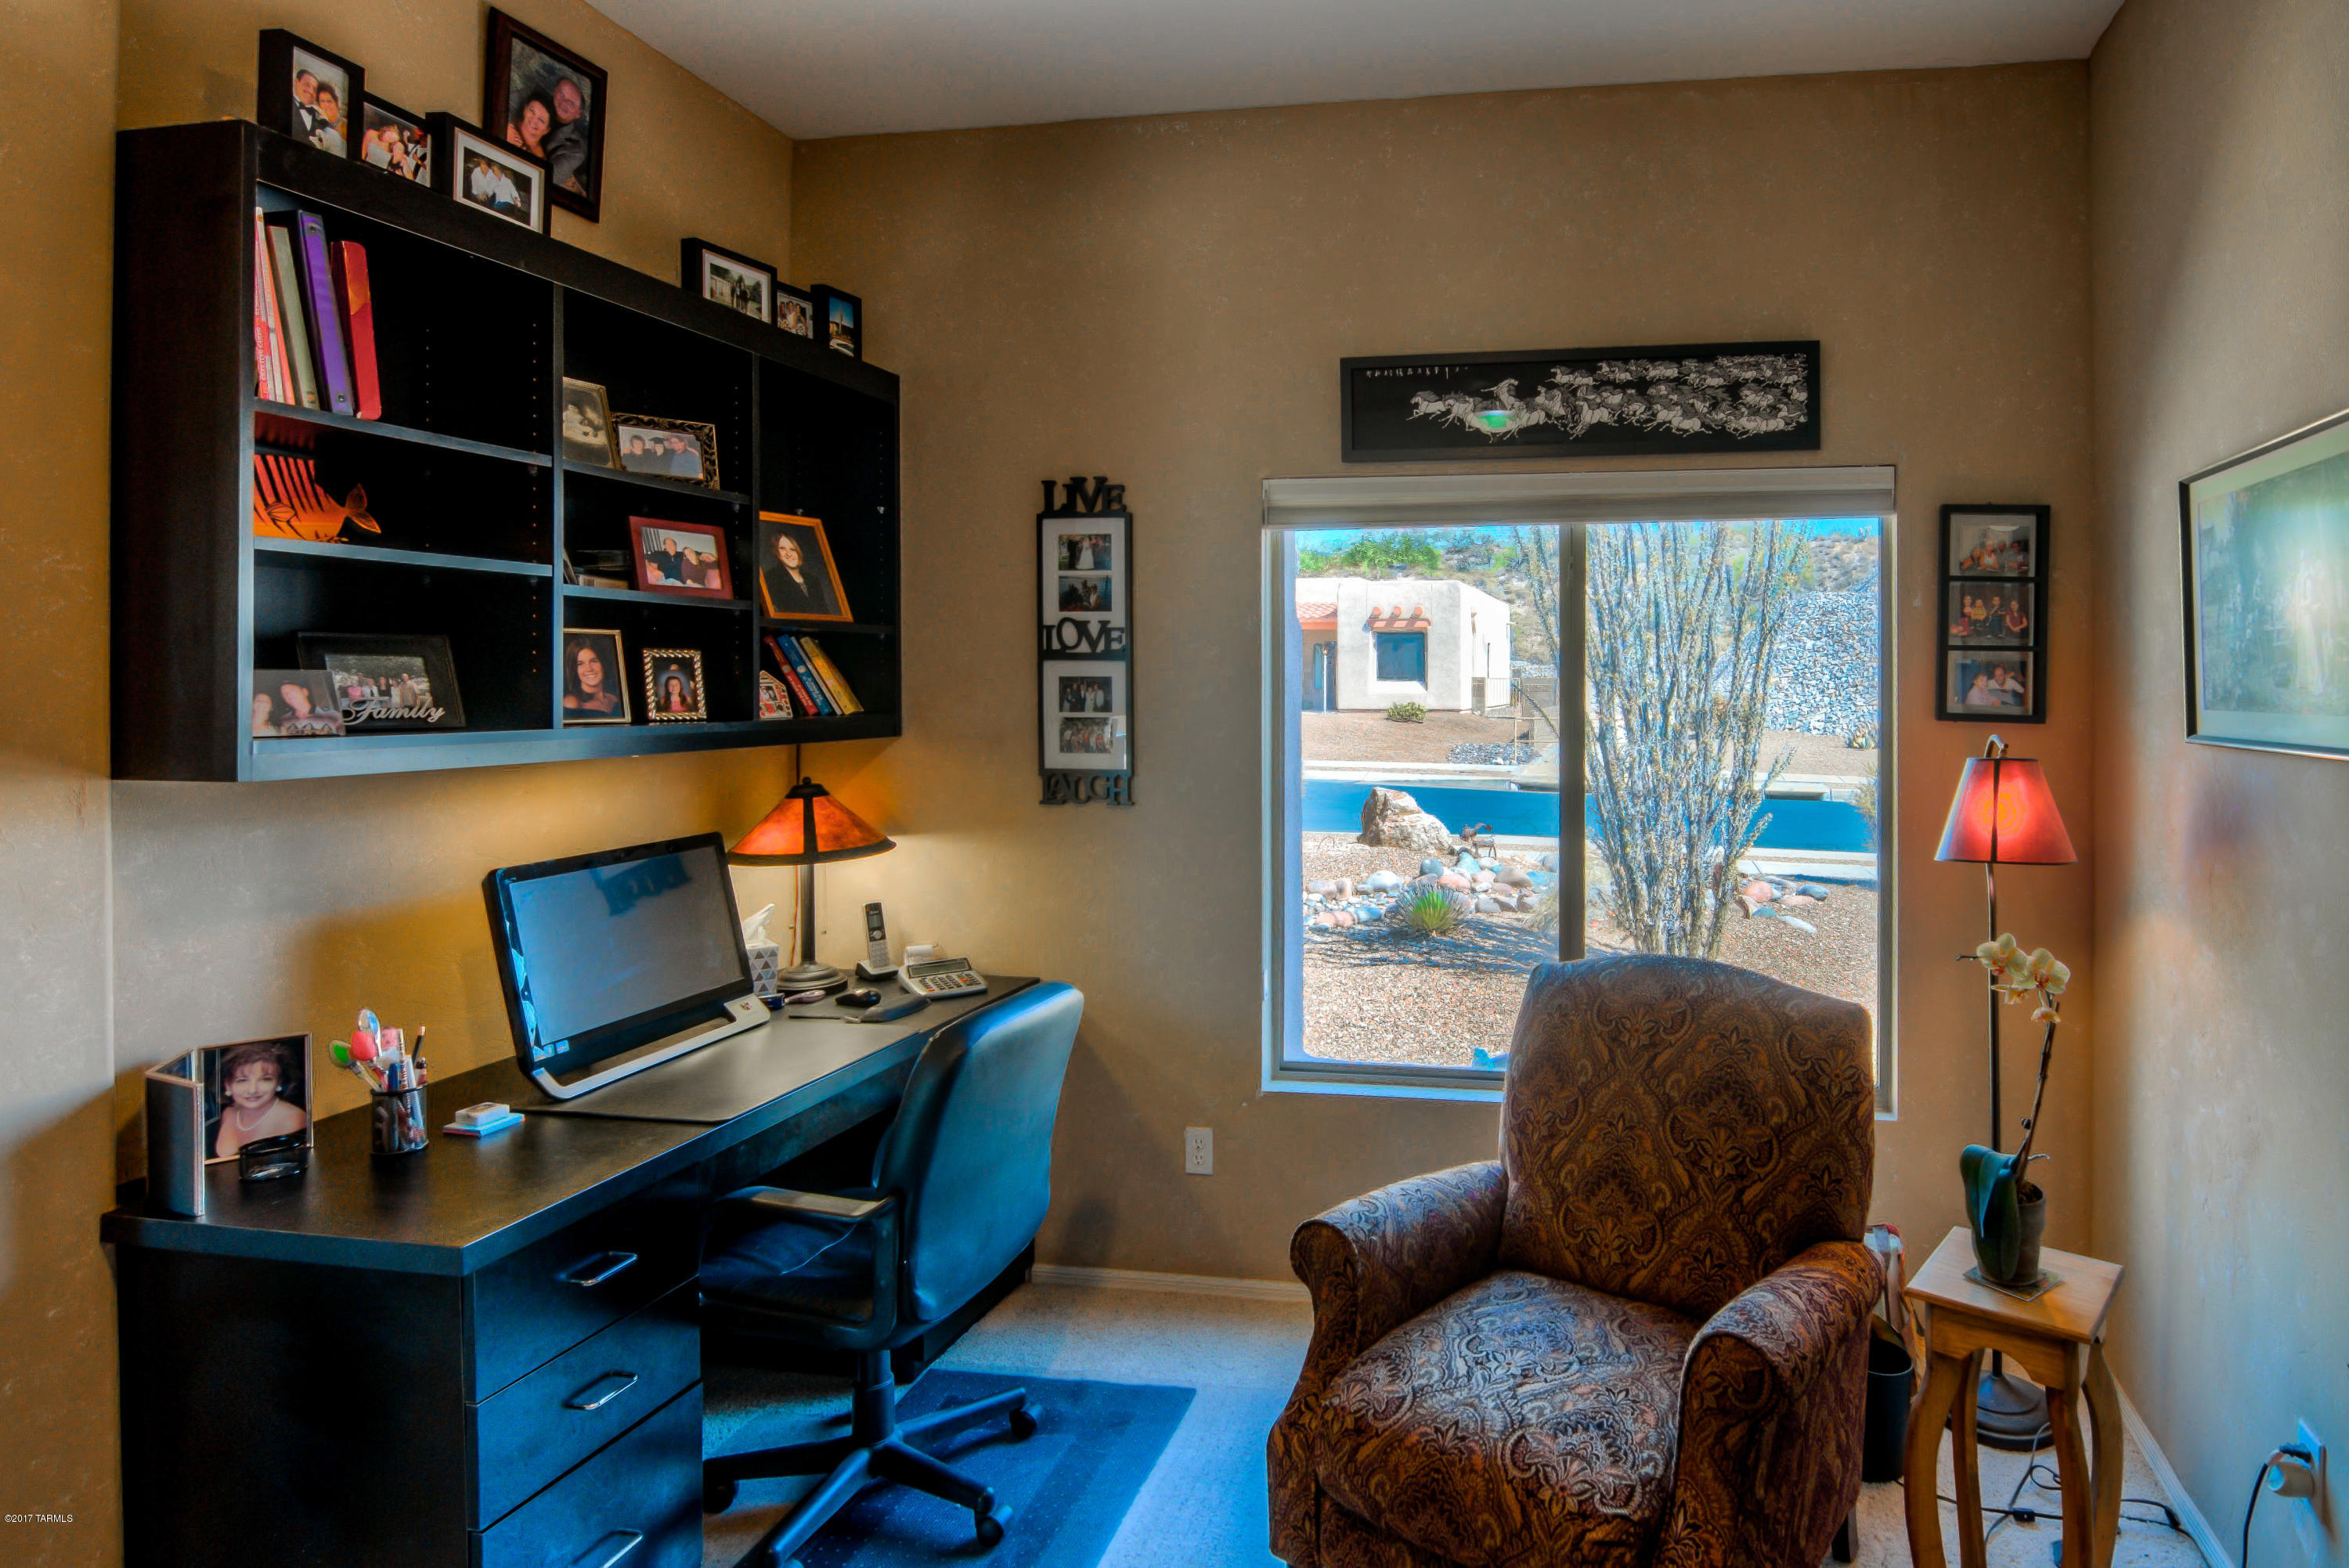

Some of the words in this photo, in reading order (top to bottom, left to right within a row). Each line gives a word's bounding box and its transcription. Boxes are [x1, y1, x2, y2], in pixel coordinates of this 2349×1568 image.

[1041, 476, 1127, 514] LIVE
[1042, 616, 1125, 654] LOVE
[341, 695, 446, 725] Family
[1039, 772, 1135, 806] LAUGH
